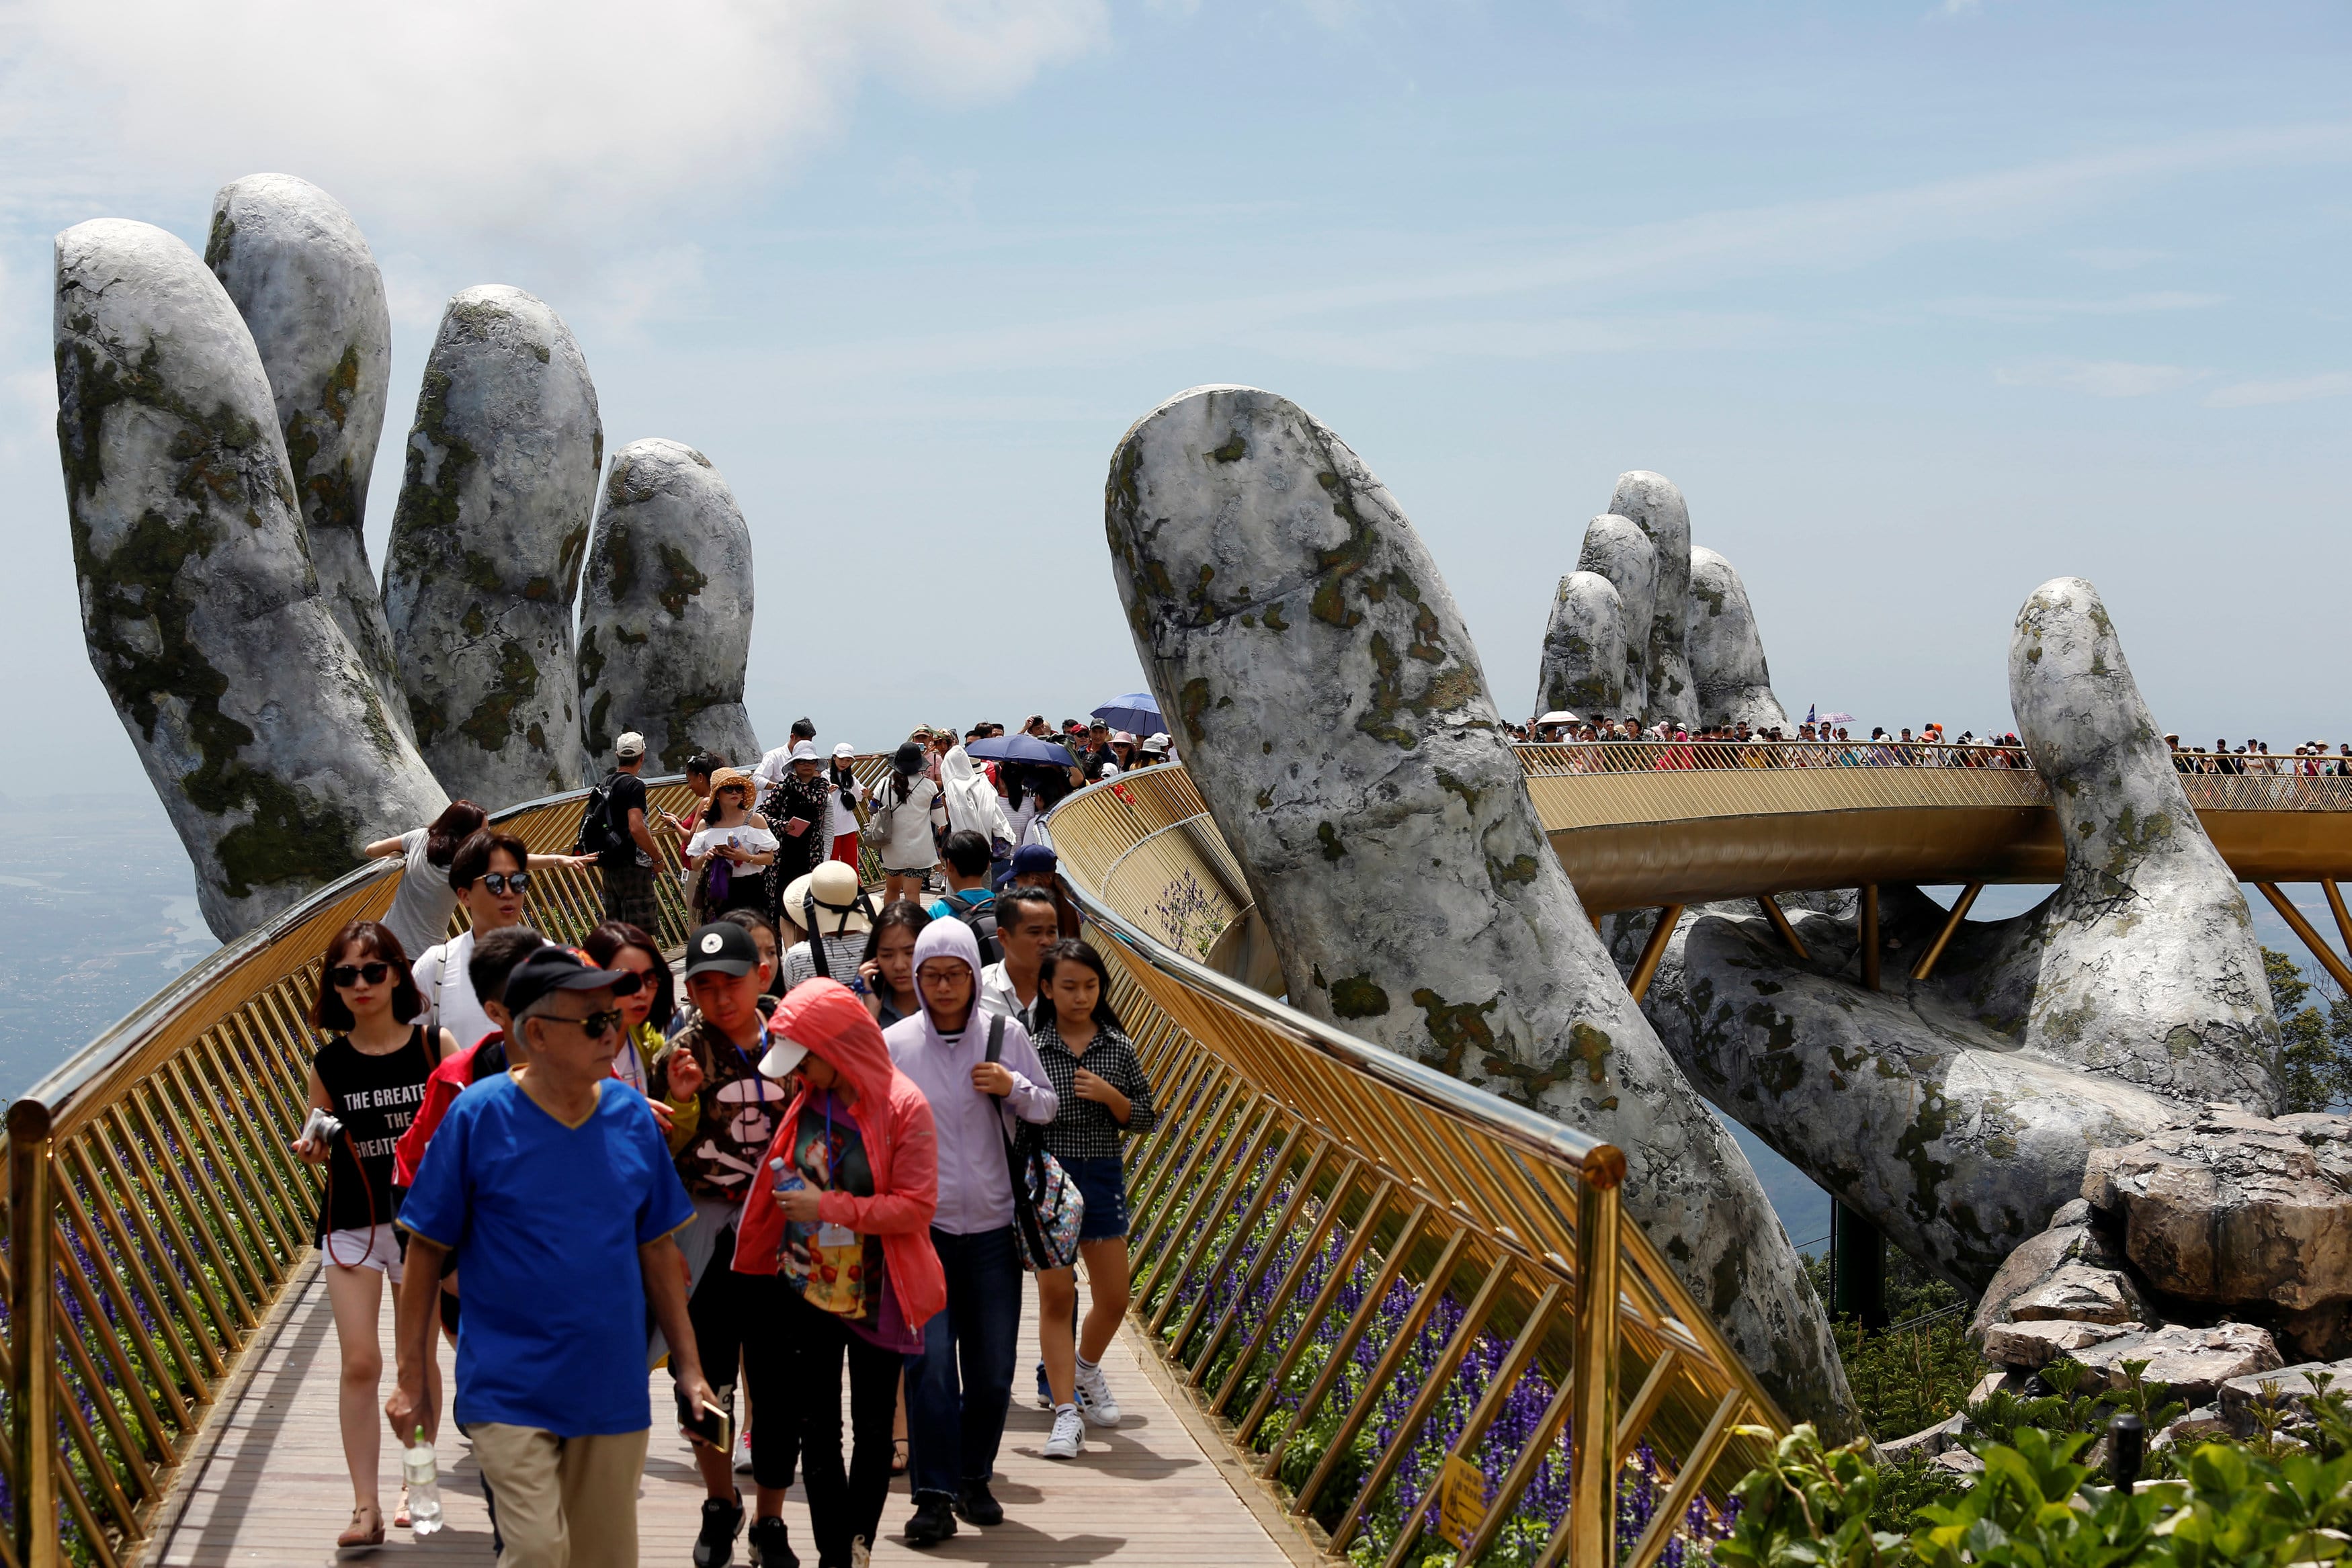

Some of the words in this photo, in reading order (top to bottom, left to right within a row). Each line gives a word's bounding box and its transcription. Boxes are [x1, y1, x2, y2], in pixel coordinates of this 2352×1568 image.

[343, 1091, 370, 1111] THE
[373, 1083, 426, 1107] GREATE
[384, 1111, 413, 1129] THE
[353, 1135, 402, 1158] GREATE
